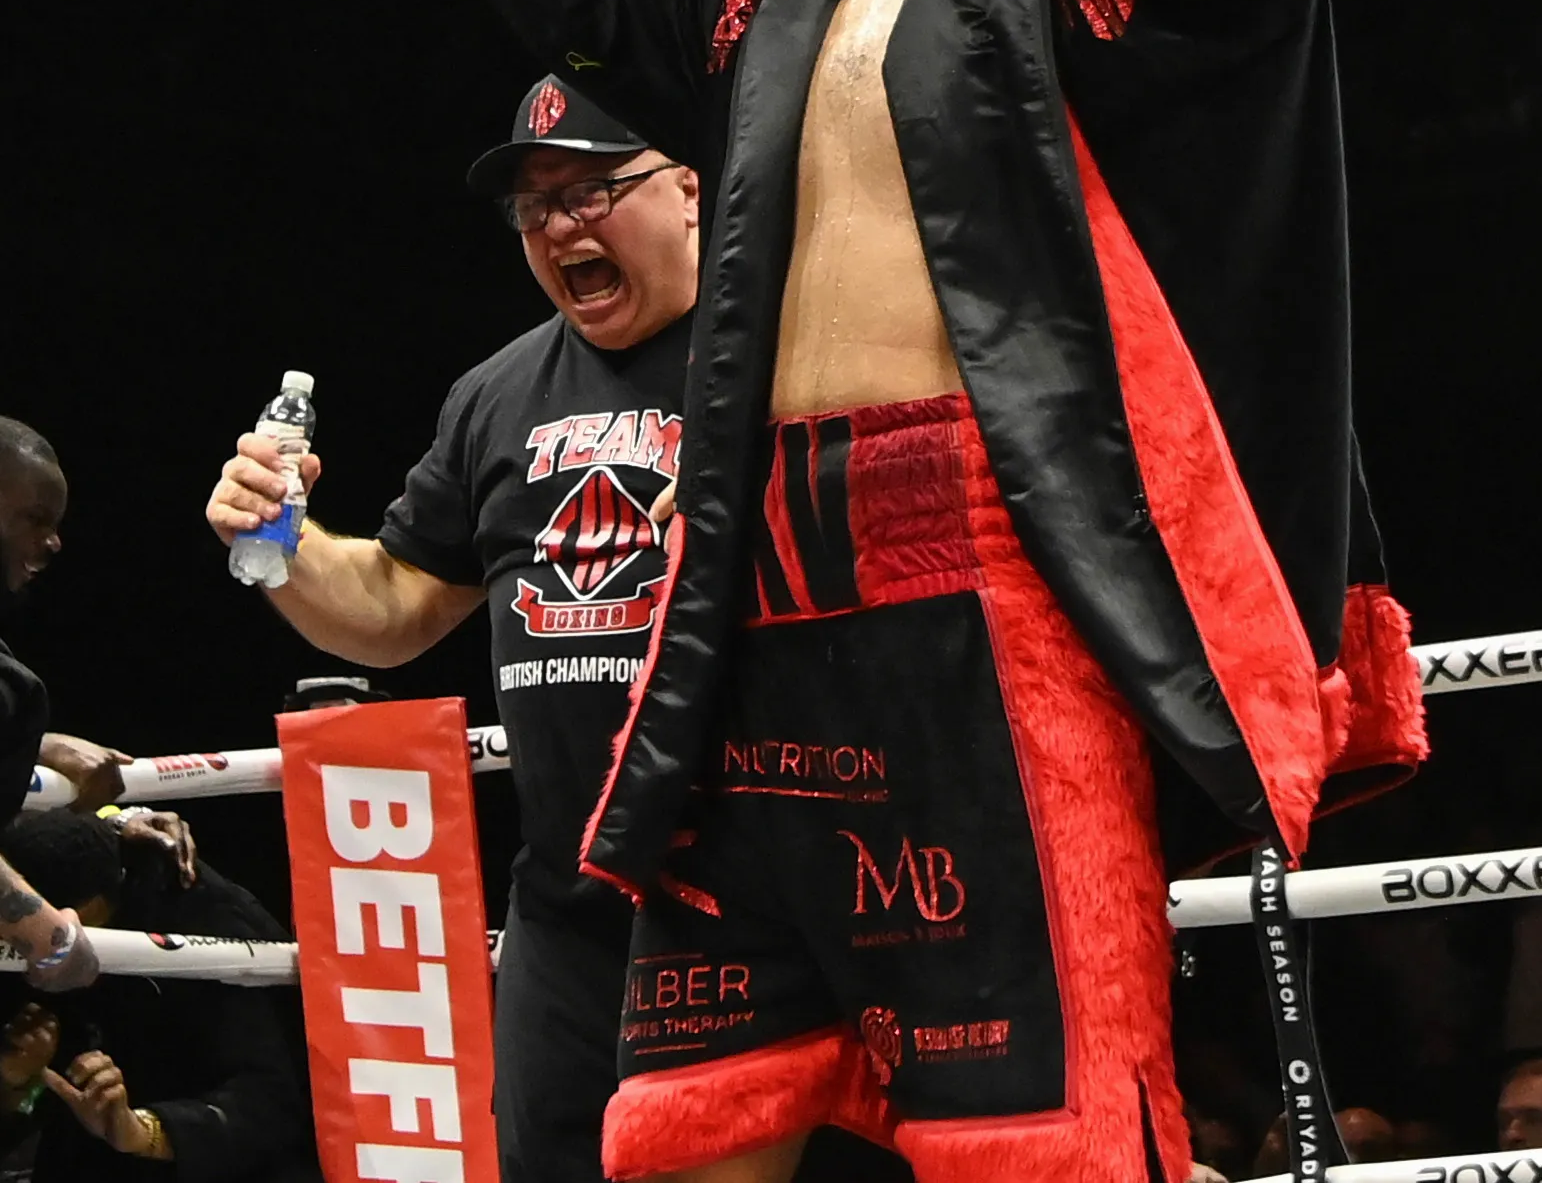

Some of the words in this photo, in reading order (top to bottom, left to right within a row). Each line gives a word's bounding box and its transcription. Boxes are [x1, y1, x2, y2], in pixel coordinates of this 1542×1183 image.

[525, 408, 684, 485] TEAM
[542, 604, 627, 632] BOXING
[499, 659, 544, 692] BRITISH
[836, 829, 966, 922] MB
[1266, 924, 1299, 1023] SEASON
